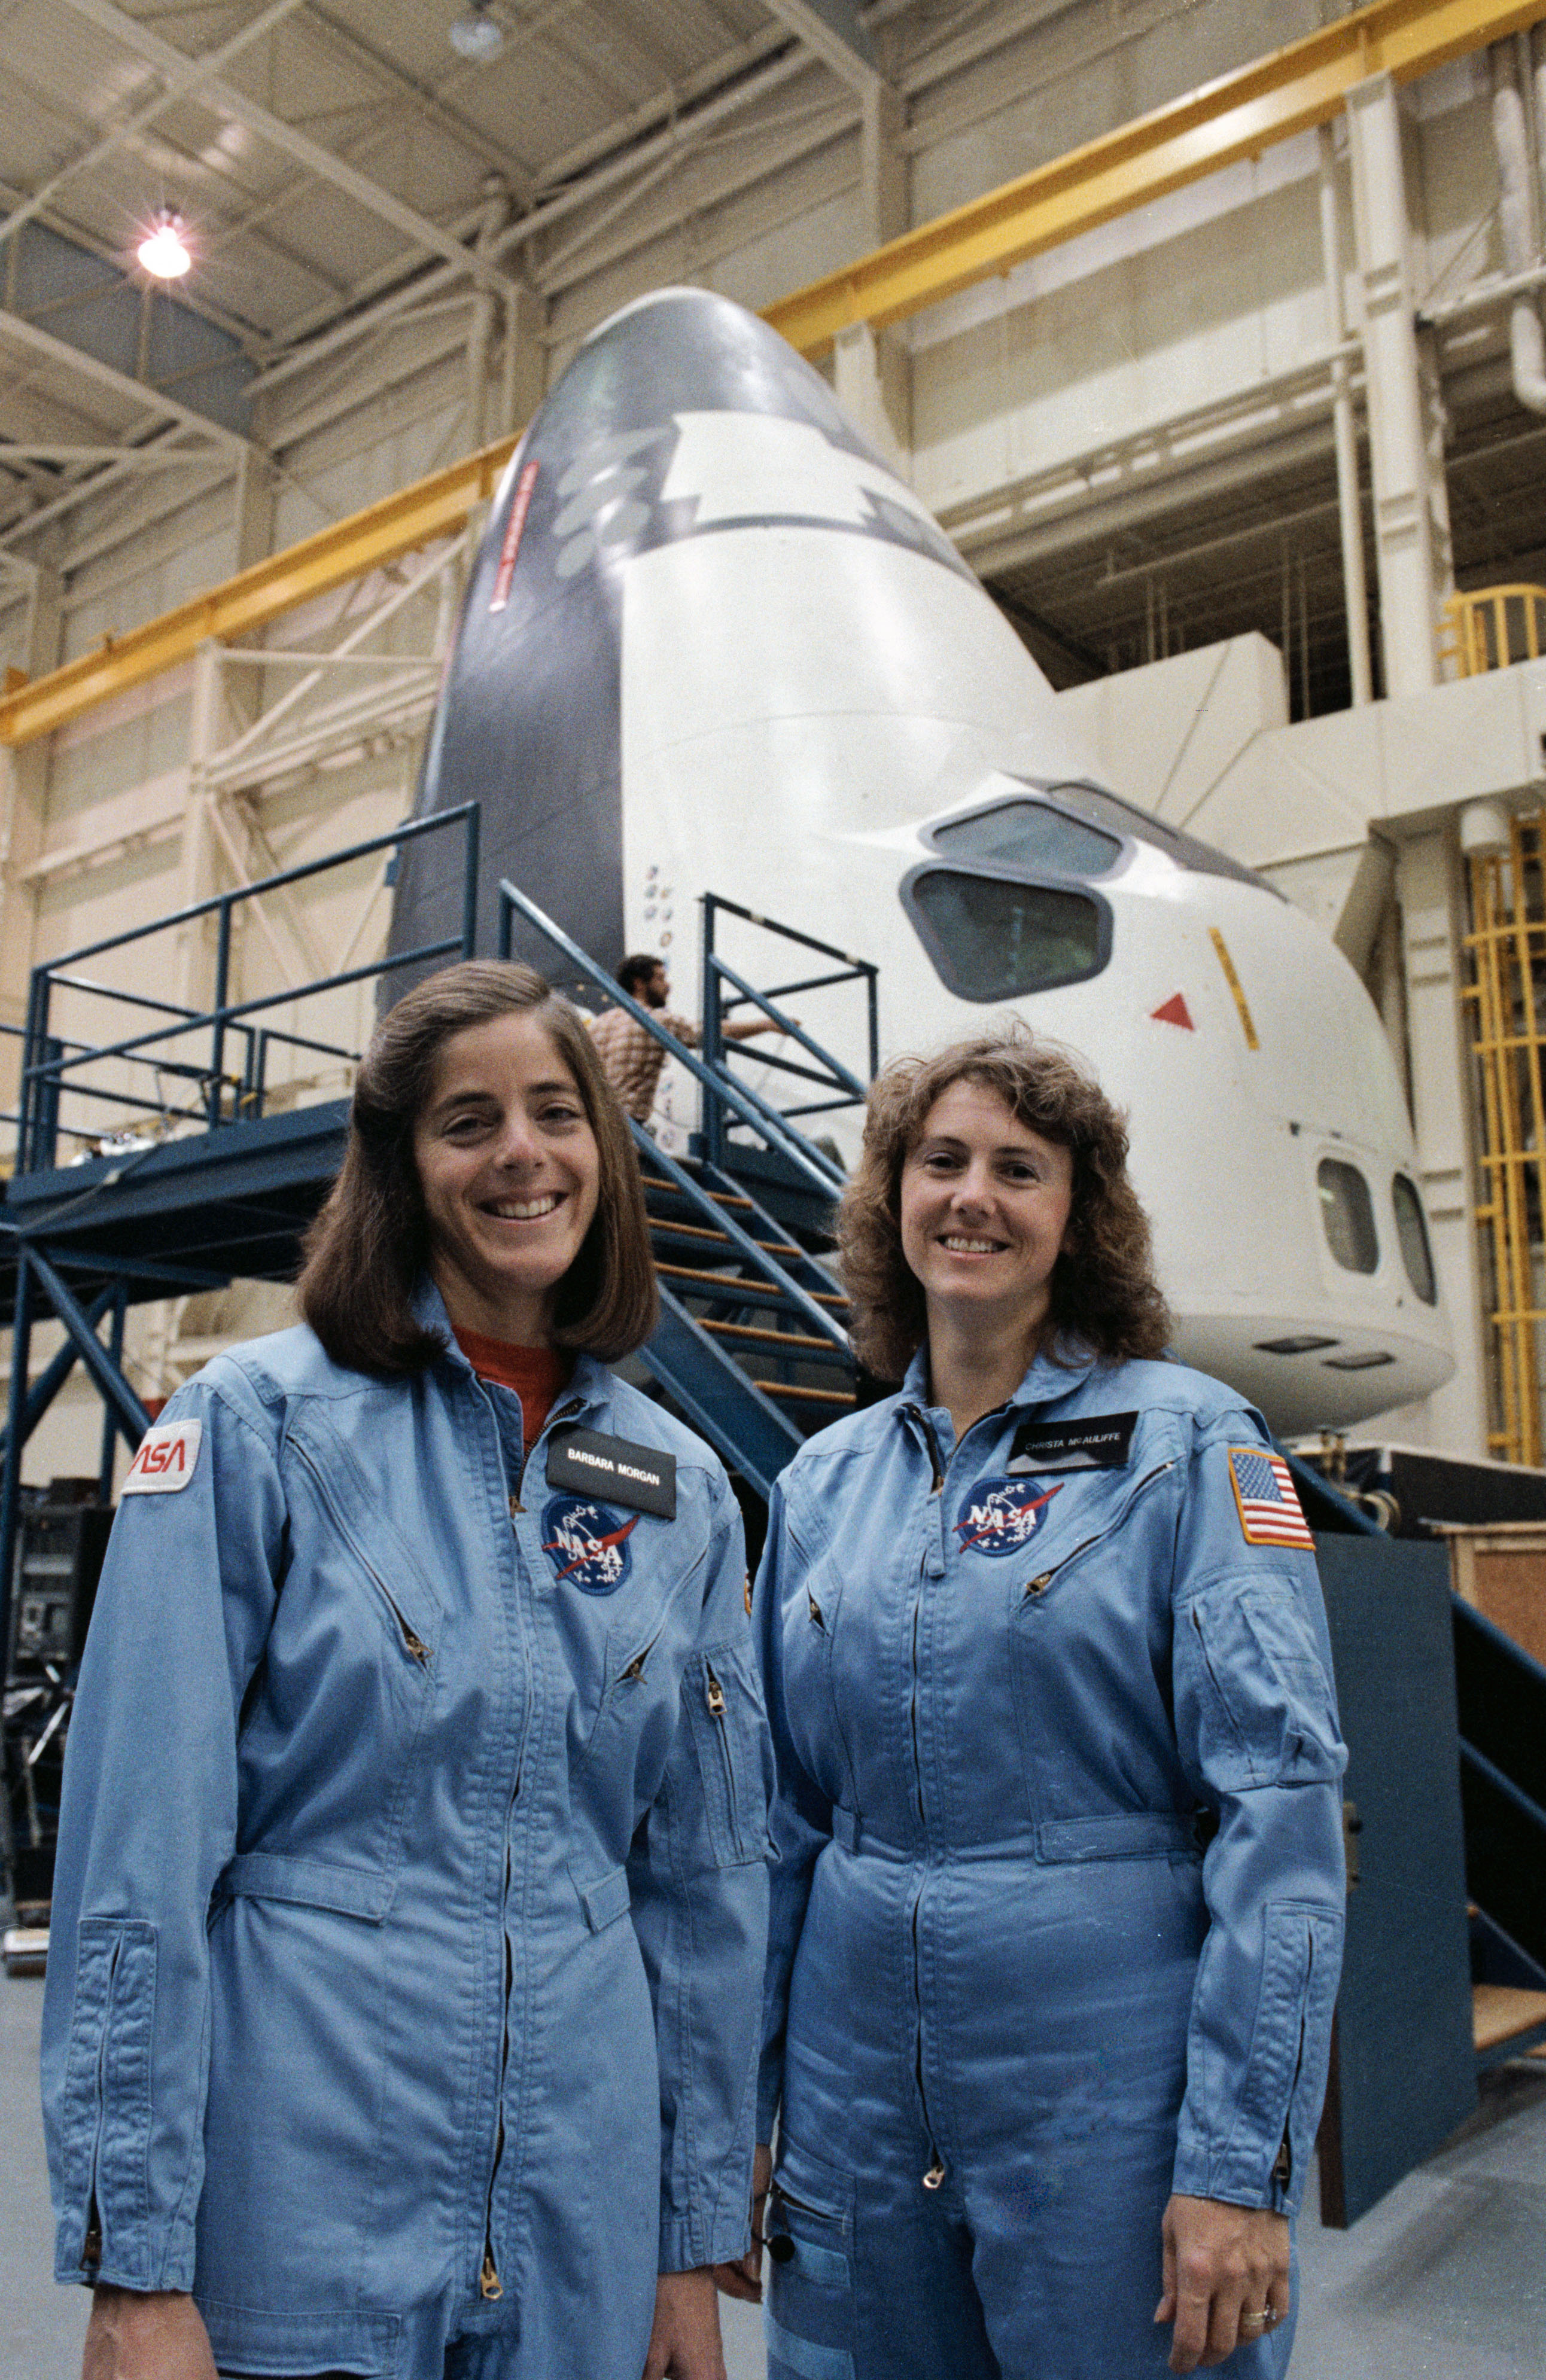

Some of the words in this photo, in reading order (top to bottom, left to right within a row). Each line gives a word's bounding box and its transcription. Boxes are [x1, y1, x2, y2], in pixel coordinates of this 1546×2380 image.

[127, 1439, 185, 1476] ASA
[1025, 1439, 1064, 1450] CHRISTA
[568, 1447, 614, 1471] BARBARA
[618, 1463, 660, 1486] MORGAN
[967, 1505, 1036, 1528] NASA
[553, 1526, 623, 1565] NASA
